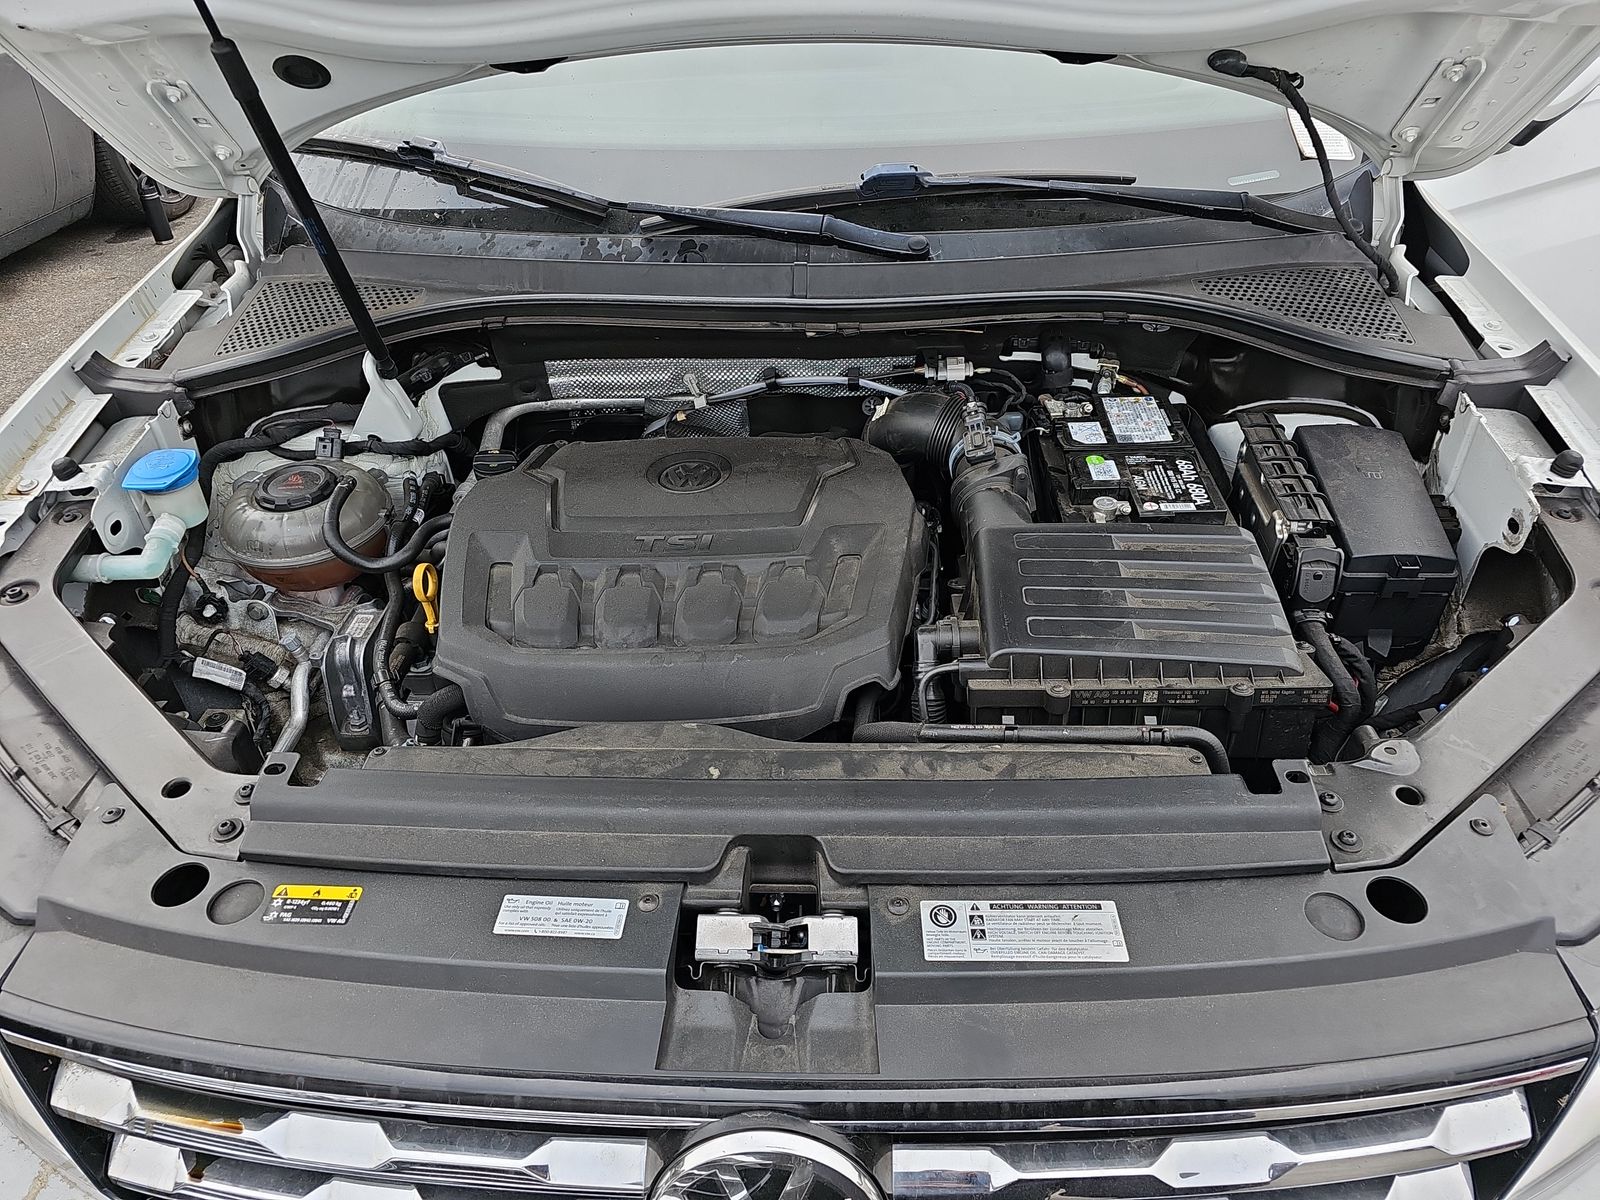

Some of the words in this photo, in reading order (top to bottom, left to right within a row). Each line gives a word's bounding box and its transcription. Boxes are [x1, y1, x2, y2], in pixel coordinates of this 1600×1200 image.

[1175, 459, 1199, 481] 68Ah
[1132, 474, 1149, 490] AGM
[1186, 483, 1211, 506] 680A
[634, 535, 715, 553] TSI
[1074, 690, 1092, 698] VW
[1093, 690, 1110, 698] AG
